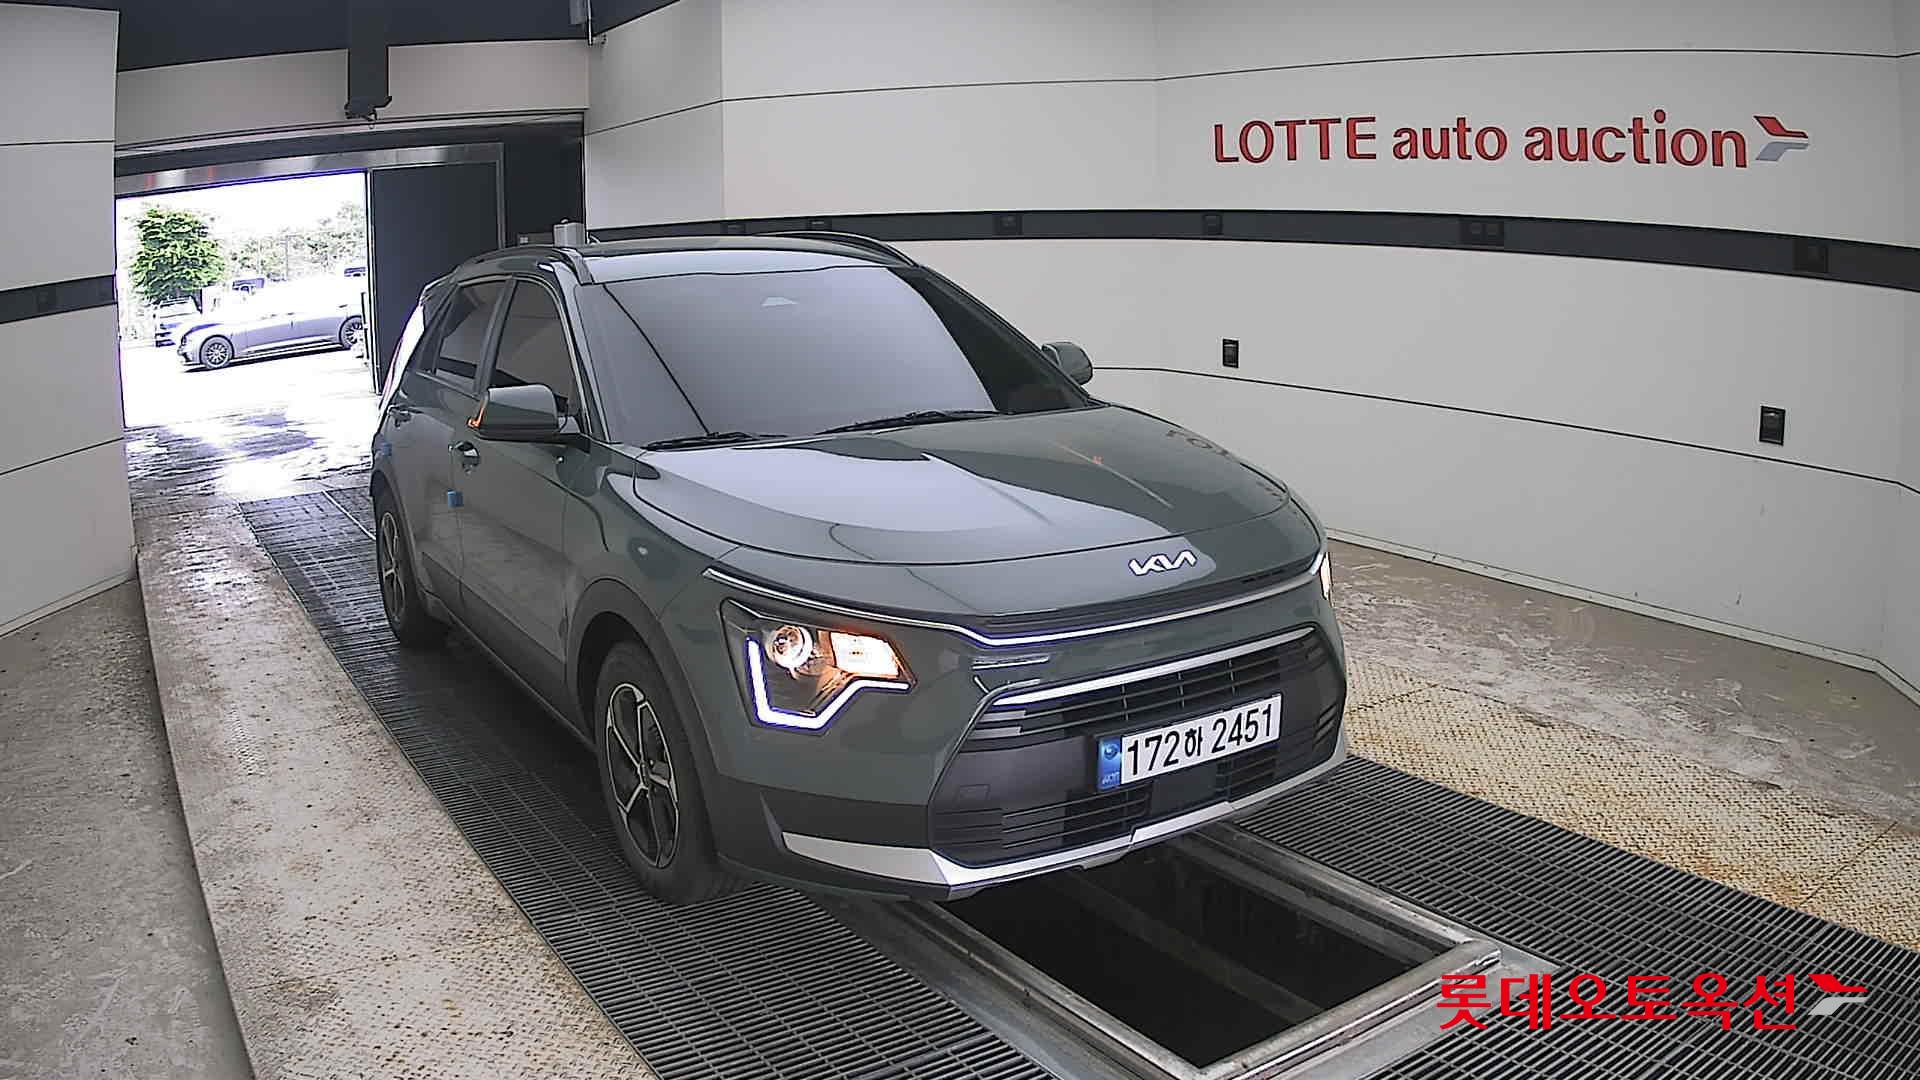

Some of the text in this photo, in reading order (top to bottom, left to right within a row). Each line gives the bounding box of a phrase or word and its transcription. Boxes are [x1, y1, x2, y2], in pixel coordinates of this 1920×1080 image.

[1213, 109, 1748, 169] LOTTE auto auction
[1127, 703, 1272, 776] 172하 2451
